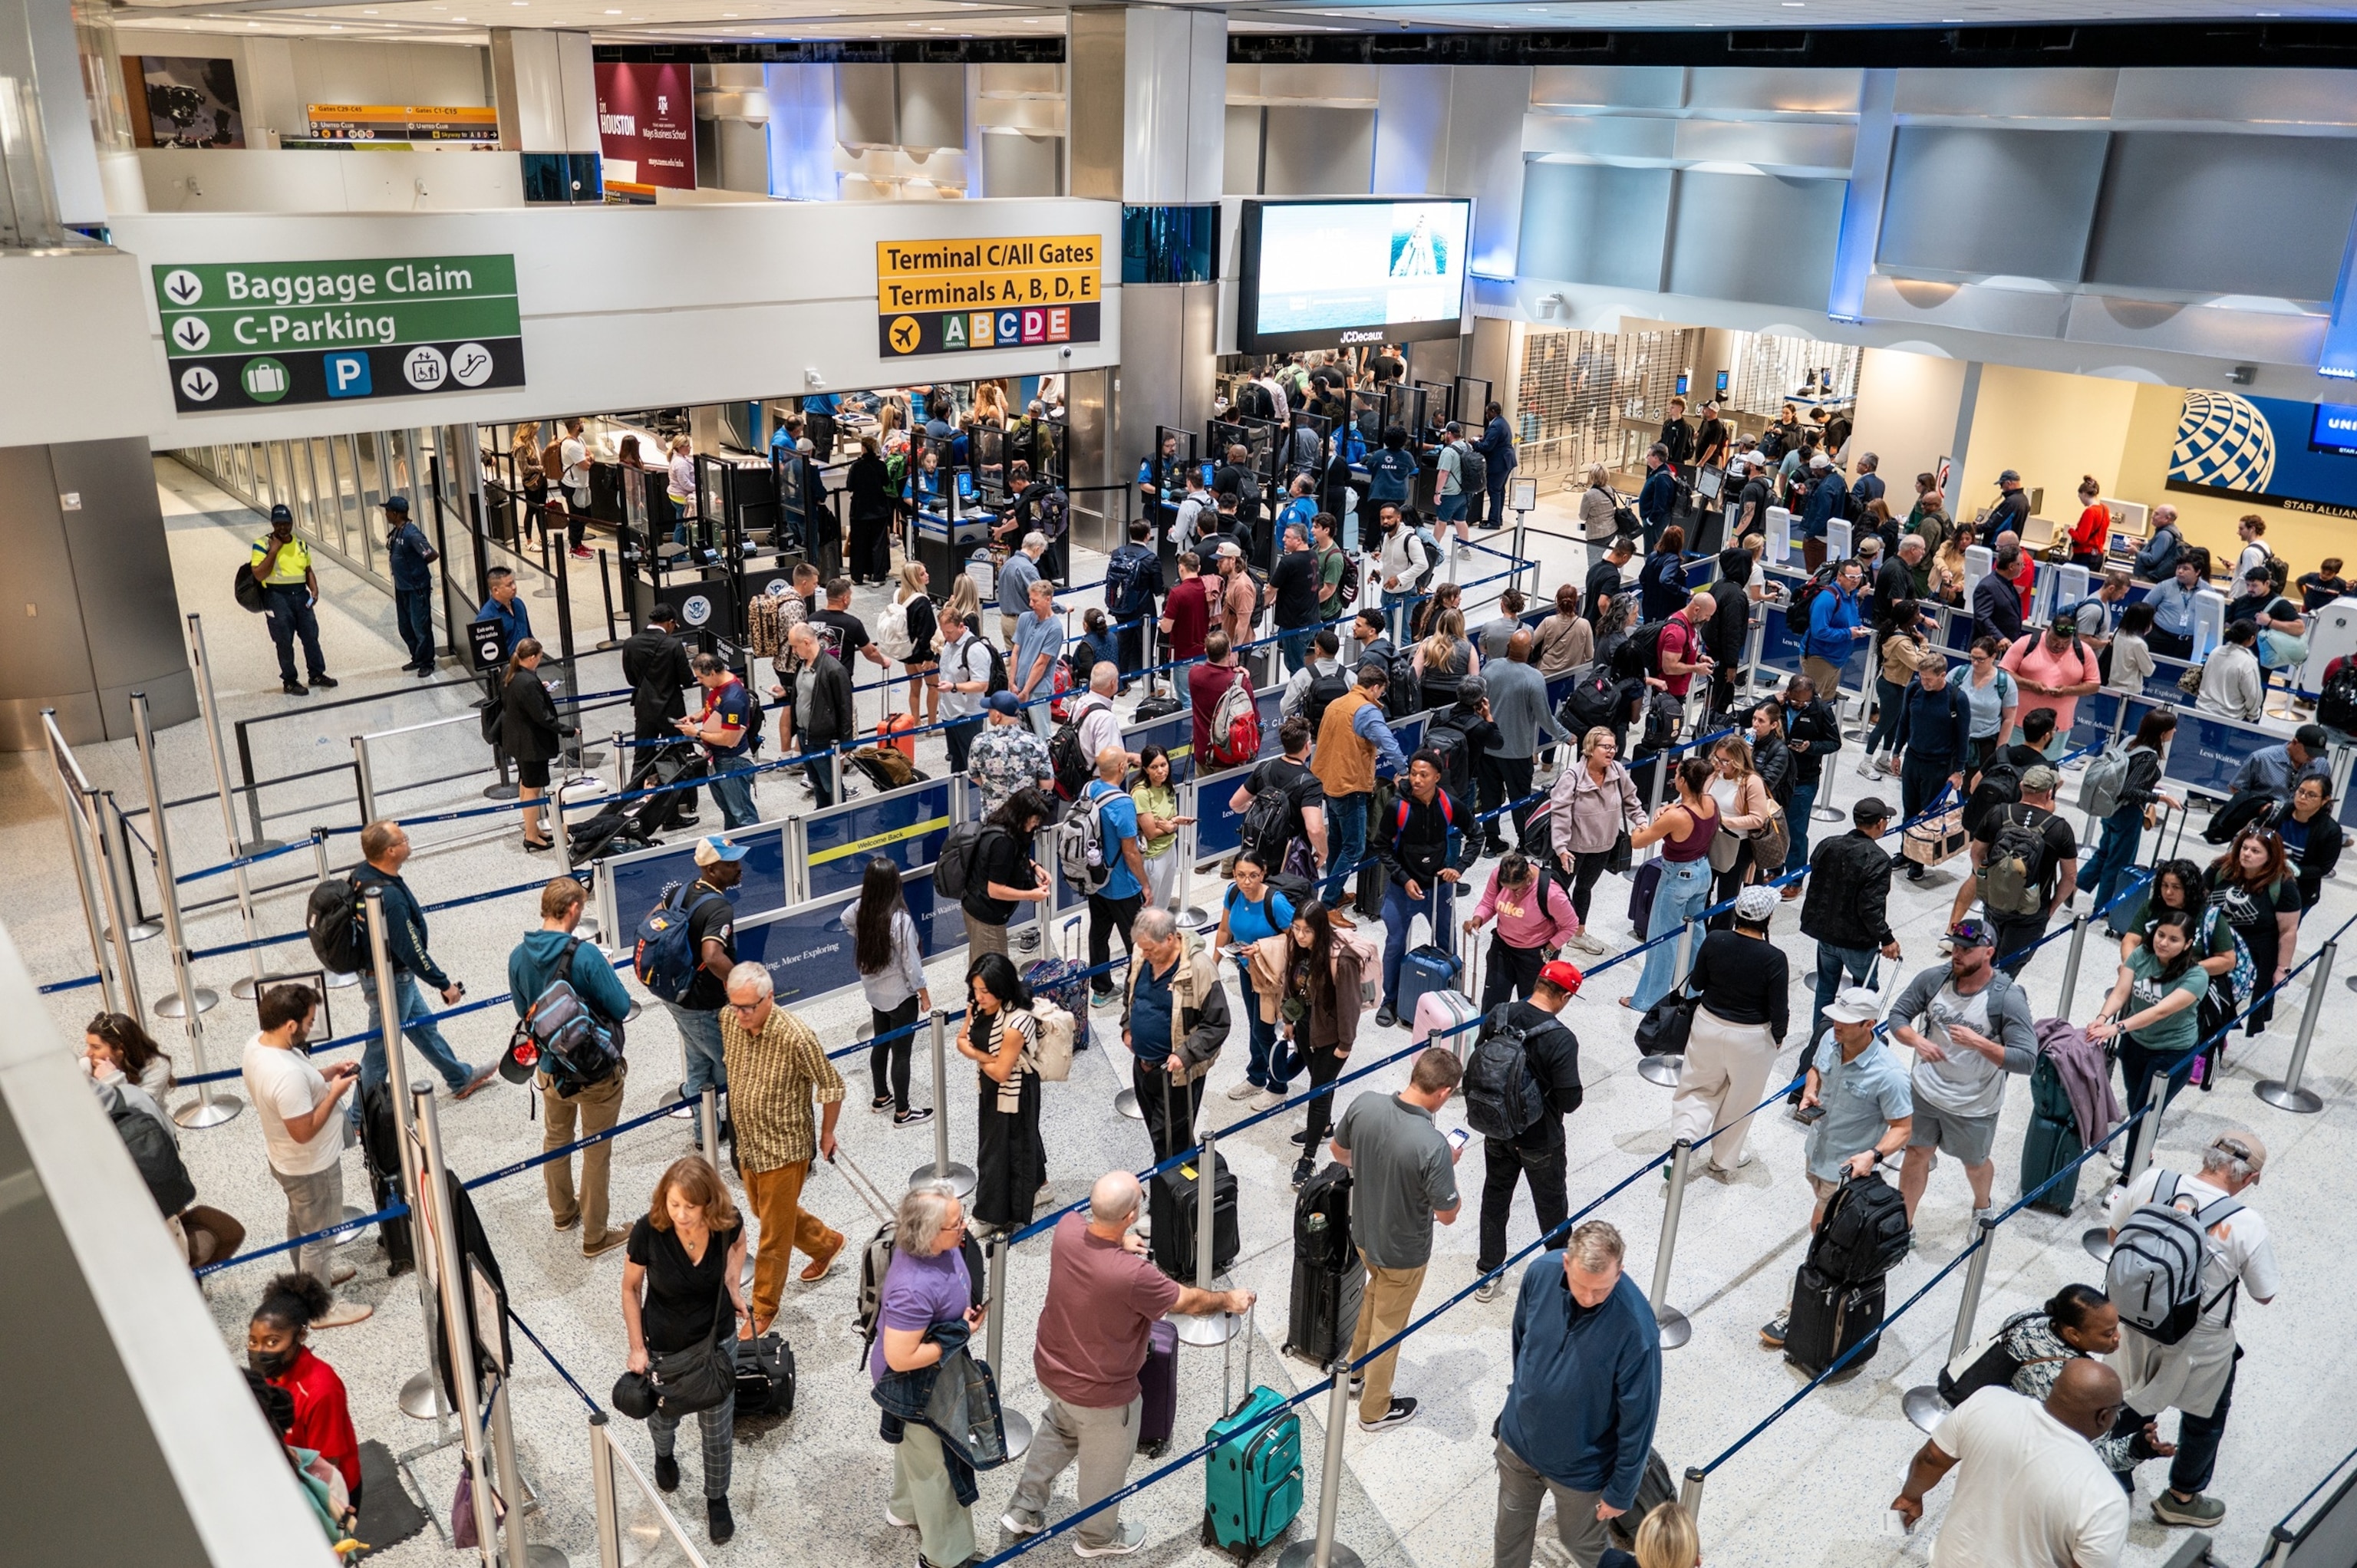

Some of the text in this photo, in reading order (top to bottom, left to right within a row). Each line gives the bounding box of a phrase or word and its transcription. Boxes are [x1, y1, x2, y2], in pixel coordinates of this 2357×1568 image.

[601, 114, 635, 136] HOUSTON
[643, 128, 687, 140] Mays Business School
[888, 242, 1094, 270] Terminal C/All Gates
[226, 264, 473, 305] Baggage Claim
[888, 276, 1091, 307] Terminals A, B, D, E
[233, 311, 397, 344] C-Parking
[945, 309, 1066, 341] A B C D E
[1340, 331, 1383, 344] JCDecaux
[335, 358, 361, 390] P
[2283, 499, 2314, 512] STAR
[717, 638, 734, 656] Please
[717, 648, 729, 663] Wait
[2154, 687, 2184, 701] Exploring
[2077, 716, 2092, 726] More
[2199, 748, 2242, 767] Less Waiting.
[857, 831, 904, 851] Welcome Back
[921, 909, 937, 921] Less
[1497, 900, 1525, 918] nike
[782, 954, 802, 967] More
[803, 942, 840, 959] Exploring
[650, 1109, 668, 1120] UNITED
[576, 1136, 596, 1148] UNITED
[499, 1165, 520, 1177] UNITED
[332, 1223, 354, 1234] CLEAR
[1021, 1533, 1045, 1550] UNITED
